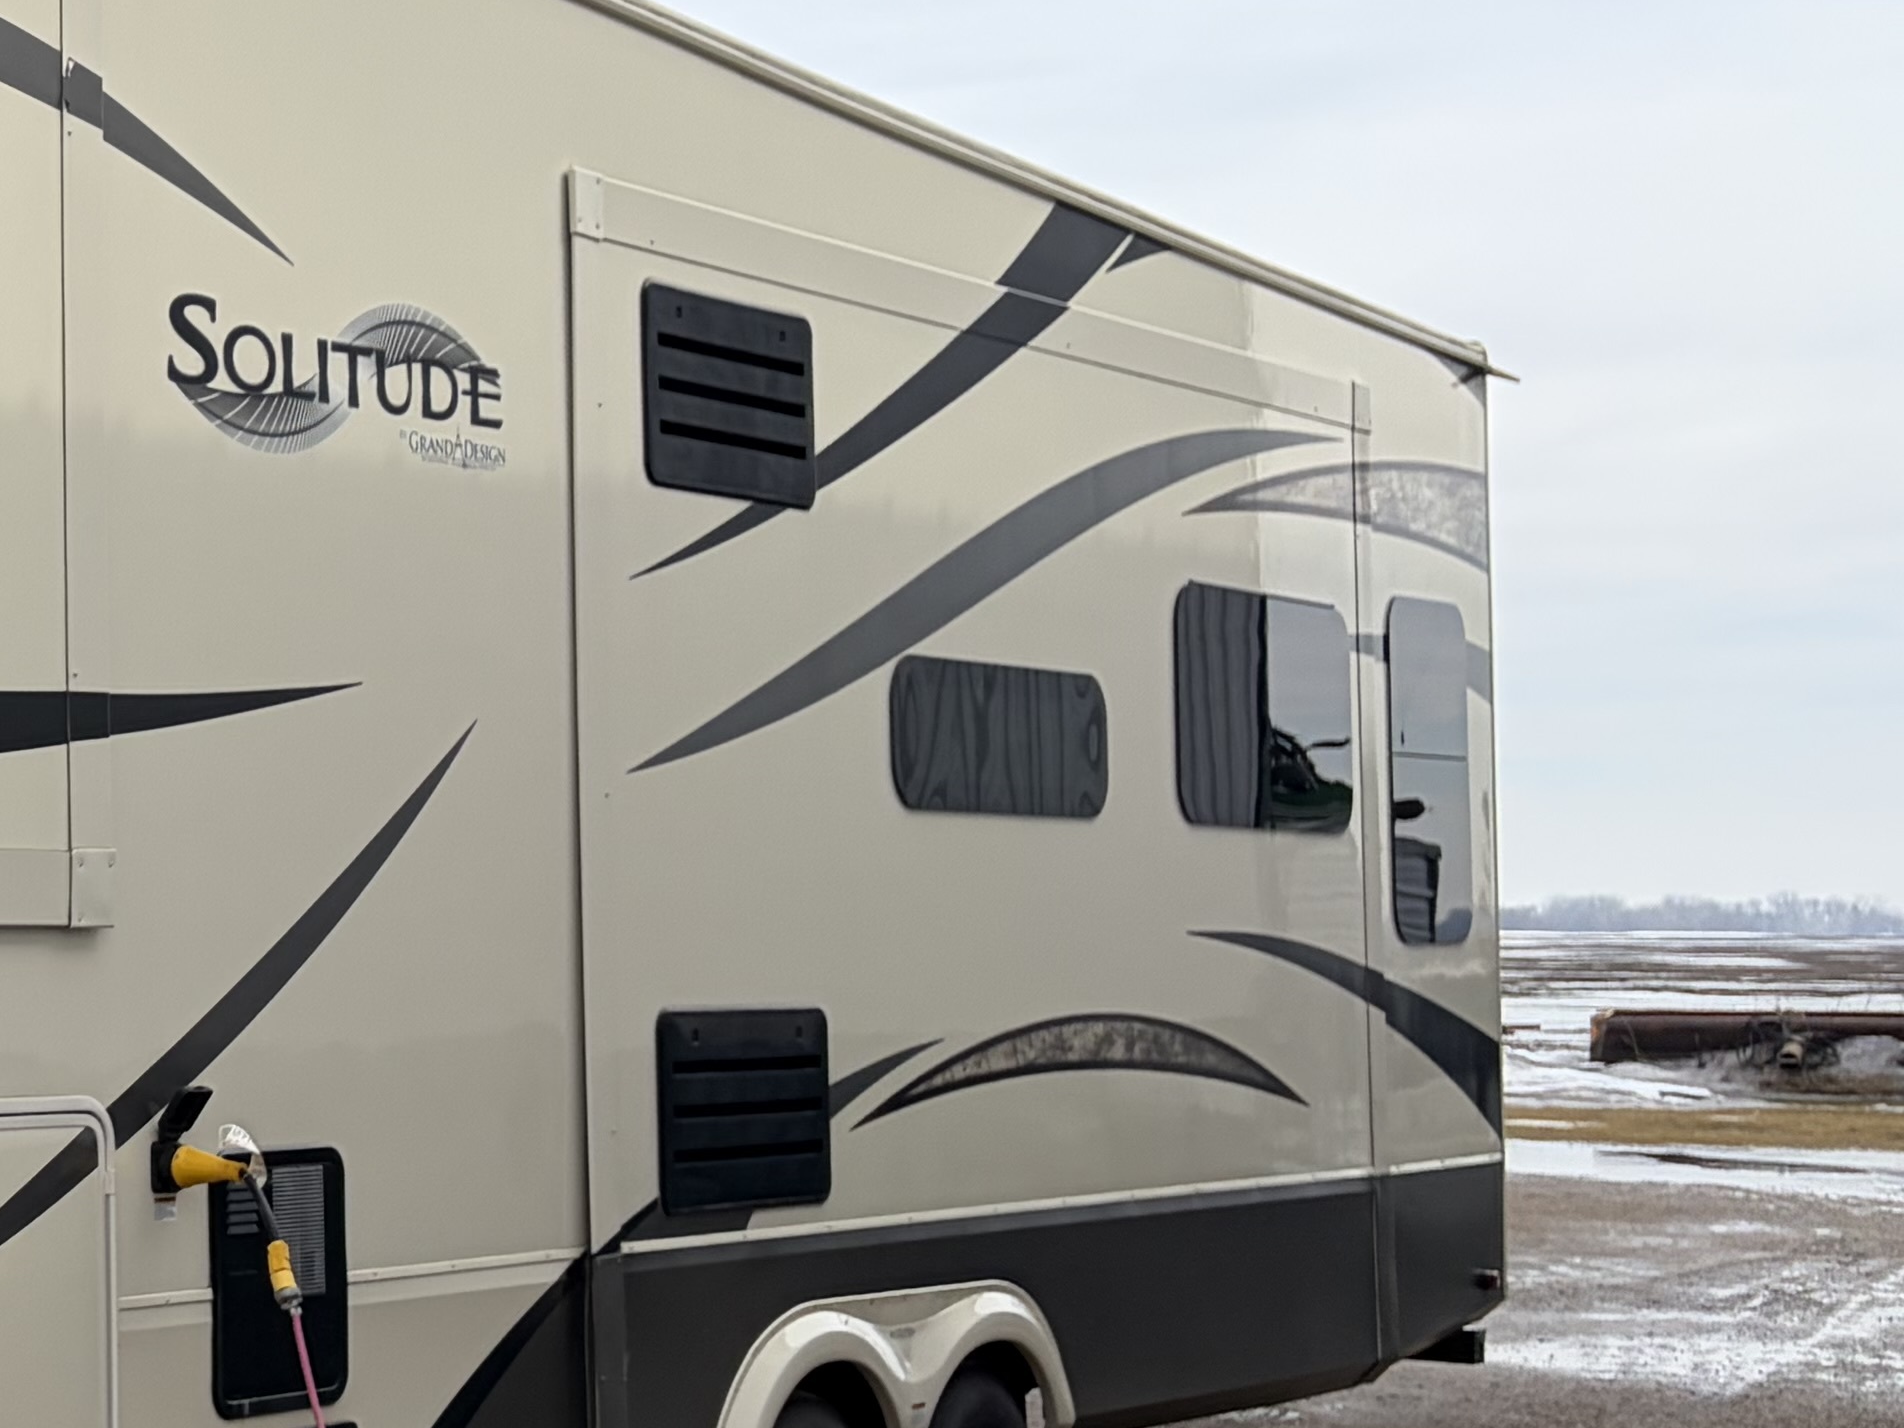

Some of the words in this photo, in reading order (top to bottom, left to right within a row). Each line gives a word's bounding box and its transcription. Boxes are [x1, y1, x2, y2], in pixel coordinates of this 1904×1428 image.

[167, 292, 504, 429] SOLITUDE
[409, 430, 454, 455] GRAND
[464, 438, 507, 465] DESIGN
